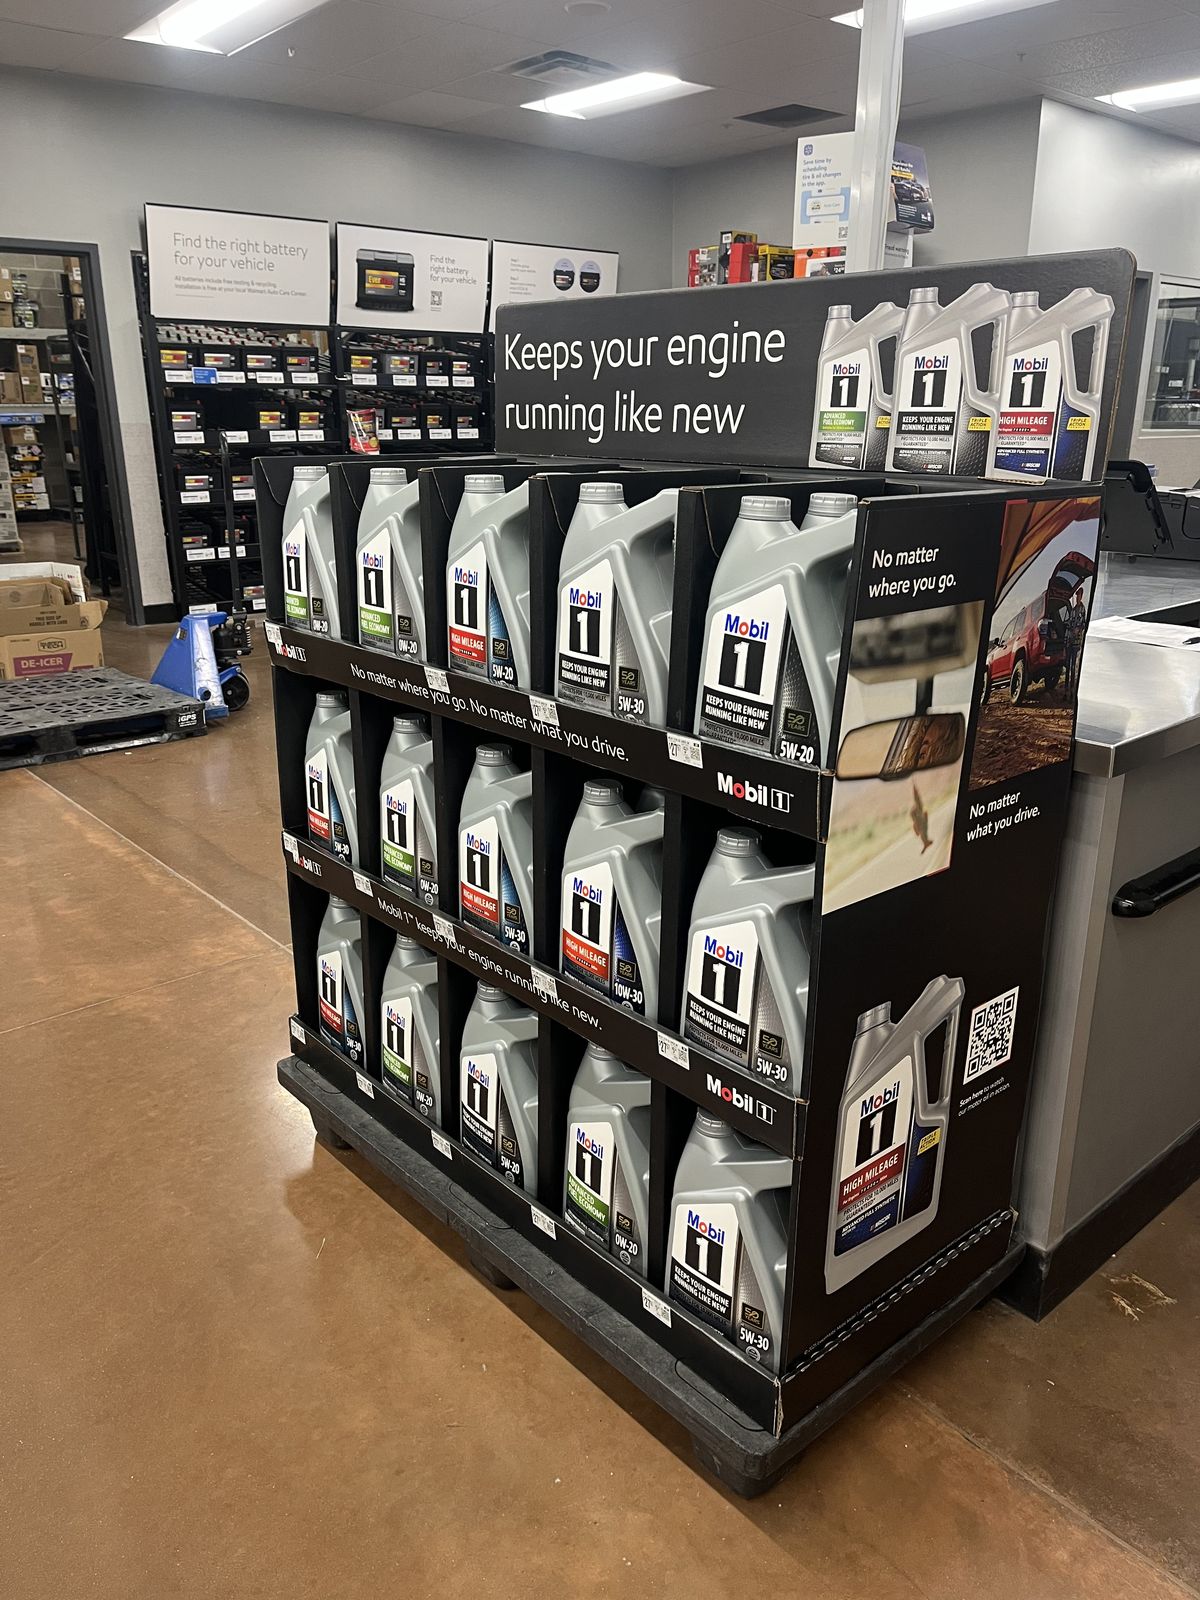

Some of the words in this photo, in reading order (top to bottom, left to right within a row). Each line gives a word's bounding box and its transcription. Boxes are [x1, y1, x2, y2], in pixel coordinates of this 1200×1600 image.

[174, 233, 201, 250] Find
[205, 236, 226, 250] the
[230, 239, 260, 256] right
[264, 241, 308, 260] battery
[430, 254, 444, 263] Find
[174, 250, 194, 265] for
[197, 257, 227, 270] your
[230, 257, 275, 272] vehicle
[430, 264, 445, 274] right
[446, 266, 468, 276] battery
[430, 273, 440, 282] for
[456, 276, 477, 285] vehicle
[504, 333, 583, 380] Keeps
[591, 337, 659, 380] your
[667, 320, 786, 378] engine
[914, 355, 948, 369] Mobil
[832, 363, 860, 374] Mobil
[1013, 358, 1048, 371] Mobil
[505, 394, 605, 443] running
[614, 390, 673, 432] like
[682, 403, 755, 434] new
[935, 416, 953, 424] ENGINE
[999, 416, 1015, 424] HIGH
[363, 552, 384, 568] Mobil
[872, 549, 893, 569] No
[895, 546, 940, 567] matter
[455, 567, 478, 586] Mobil
[869, 577, 910, 598] where
[912, 576, 936, 598] you
[937, 574, 957, 594] go.
[569, 587, 602, 609] Mobil
[724, 613, 770, 641] Mobil
[399, 640, 417, 654] 0W-20
[21, 657, 63, 668] DE-ICER
[492, 664, 513, 680] 5W-20
[350, 663, 365, 680] No
[368, 670, 397, 689] matter
[398, 678, 429, 699] where
[430, 687, 450, 705] you
[452, 696, 469, 712] go.
[469, 698, 488, 717] No
[490, 707, 527, 729] matter
[530, 721, 562, 741] what
[564, 731, 588, 749] you
[592, 736, 629, 761] drive.
[618, 696, 644, 714] 5W-30
[706, 693, 723, 707] KEEPS
[724, 698, 743, 713] YOUR
[743, 704, 770, 720] ENGINE
[705, 704, 732, 722] RUNNING
[733, 711, 748, 725] LIKE
[748, 715, 765, 731] NEW
[779, 740, 814, 764] 5W-20
[717, 771, 767, 807] Mobil
[386, 794, 407, 814] Mobil
[969, 803, 985, 820] No
[987, 791, 1021, 813] matter
[967, 821, 993, 842] what
[994, 816, 1013, 836] you
[1014, 806, 1040, 824] drive.
[466, 832, 490, 855] Mobil
[420, 879, 438, 894] 0W-20
[573, 877, 602, 904] Mobil
[505, 925, 526, 942] 5W-30
[377, 897, 403, 921] Mobil
[416, 918, 443, 944] keeps
[444, 938, 466, 954] your
[469, 948, 503, 976] engine
[505, 969, 548, 1003] running
[572, 1006, 602, 1030] new.
[566, 937, 579, 951] HIGH
[579, 943, 606, 968] MILEAGE
[704, 935, 744, 968] Mobil
[614, 981, 643, 1004] 10W-30
[690, 1000, 706, 1016] KEEPS
[705, 1007, 722, 1023] YOUR
[722, 1018, 746, 1037] ENGINE
[690, 1009, 713, 1030] RUNNING
[714, 1022, 727, 1038] LIKE
[727, 1030, 743, 1045] NEW
[468, 1061, 490, 1088] Mobil
[756, 1058, 787, 1082] 5W-30
[706, 1073, 753, 1115] Mobil
[860, 1080, 900, 1118] Mobil
[972, 1090, 983, 1099] here
[576, 1127, 604, 1159] Mobil
[870, 1109, 884, 1156] 1
[919, 1137, 936, 1150] ACTION
[843, 1178, 863, 1196] HIGH
[864, 1153, 899, 1182] MILEAGE
[687, 1209, 725, 1245] Mobil
[615, 1233, 638, 1256] 0W-20
[674, 1265, 691, 1282] KEEPS
[690, 1274, 706, 1293] YOUR
[706, 1285, 729, 1305] ENGINE
[674, 1274, 698, 1298] RUNNING
[698, 1289, 711, 1306] LIKE
[711, 1298, 727, 1314] NEW
[739, 1327, 769, 1351] 5W-30
